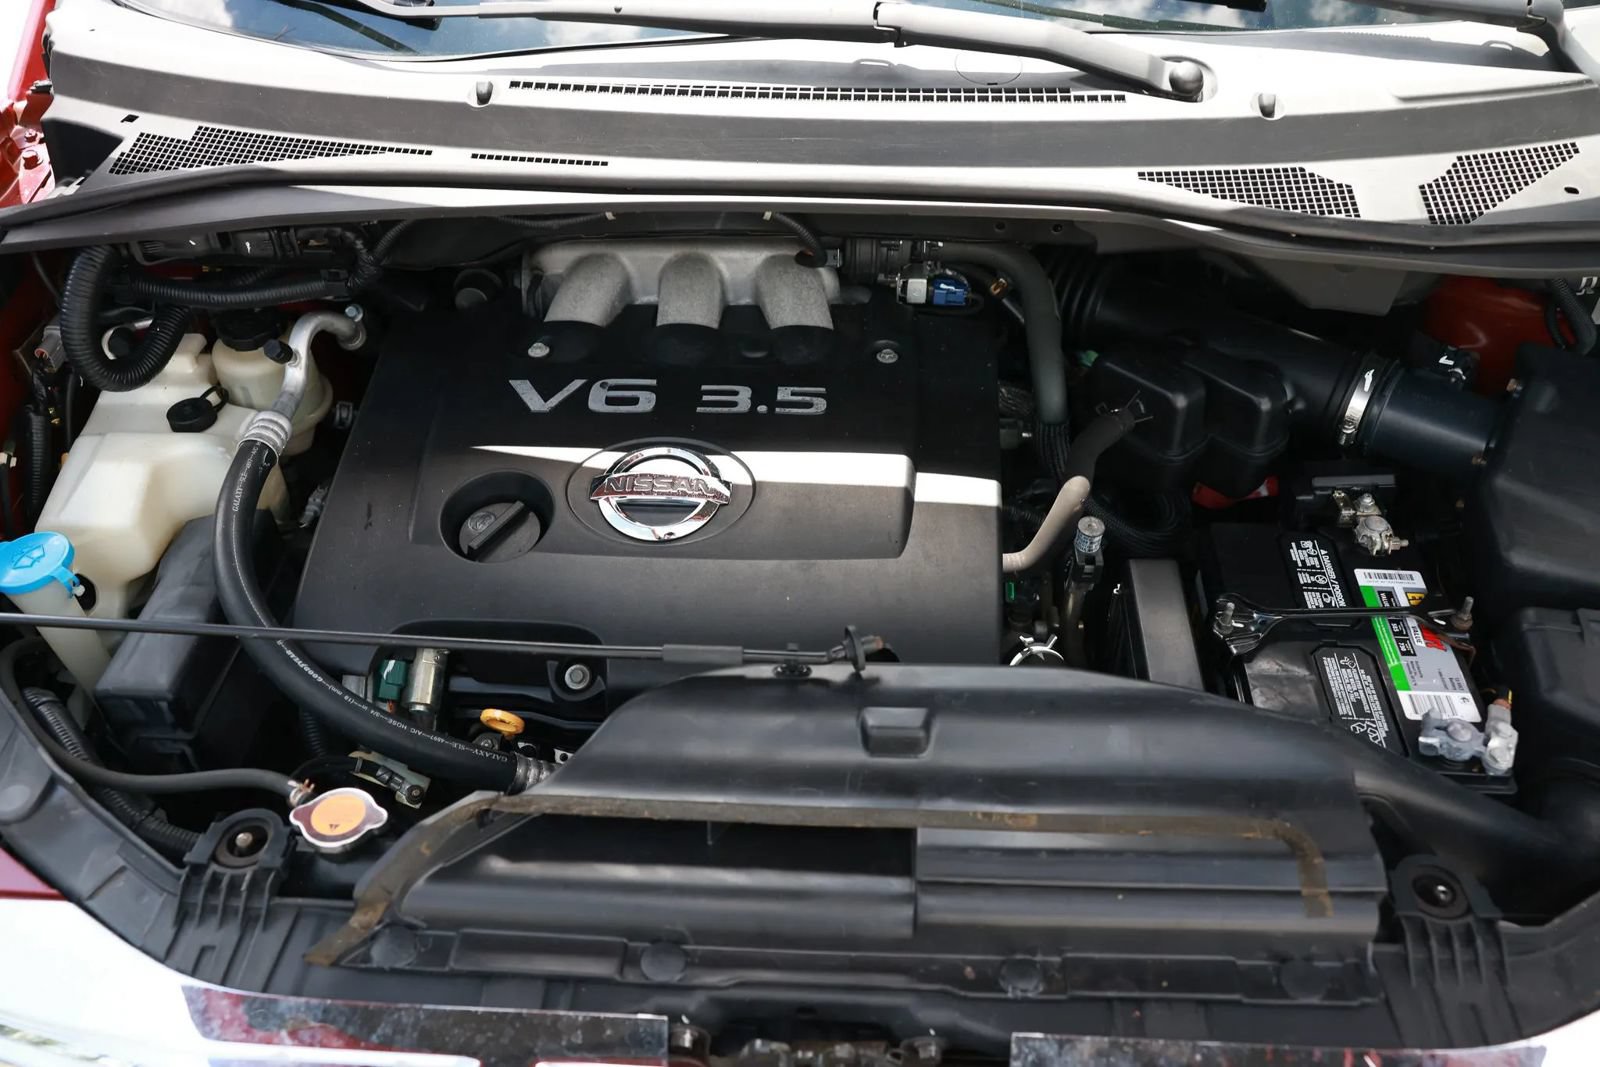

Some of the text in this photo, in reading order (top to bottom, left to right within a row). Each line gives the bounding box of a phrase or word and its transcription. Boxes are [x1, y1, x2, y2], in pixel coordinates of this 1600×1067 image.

[508, 378, 828, 415] V6 3.5
[602, 474, 717, 497] NISSAN
[1322, 555, 1337, 580] DANGER
[1331, 584, 1347, 607] POISON
[1411, 625, 1423, 644] VALUE
[286, 649, 324, 682] GOODYEAR
[472, 748, 509, 763] GALAXY
